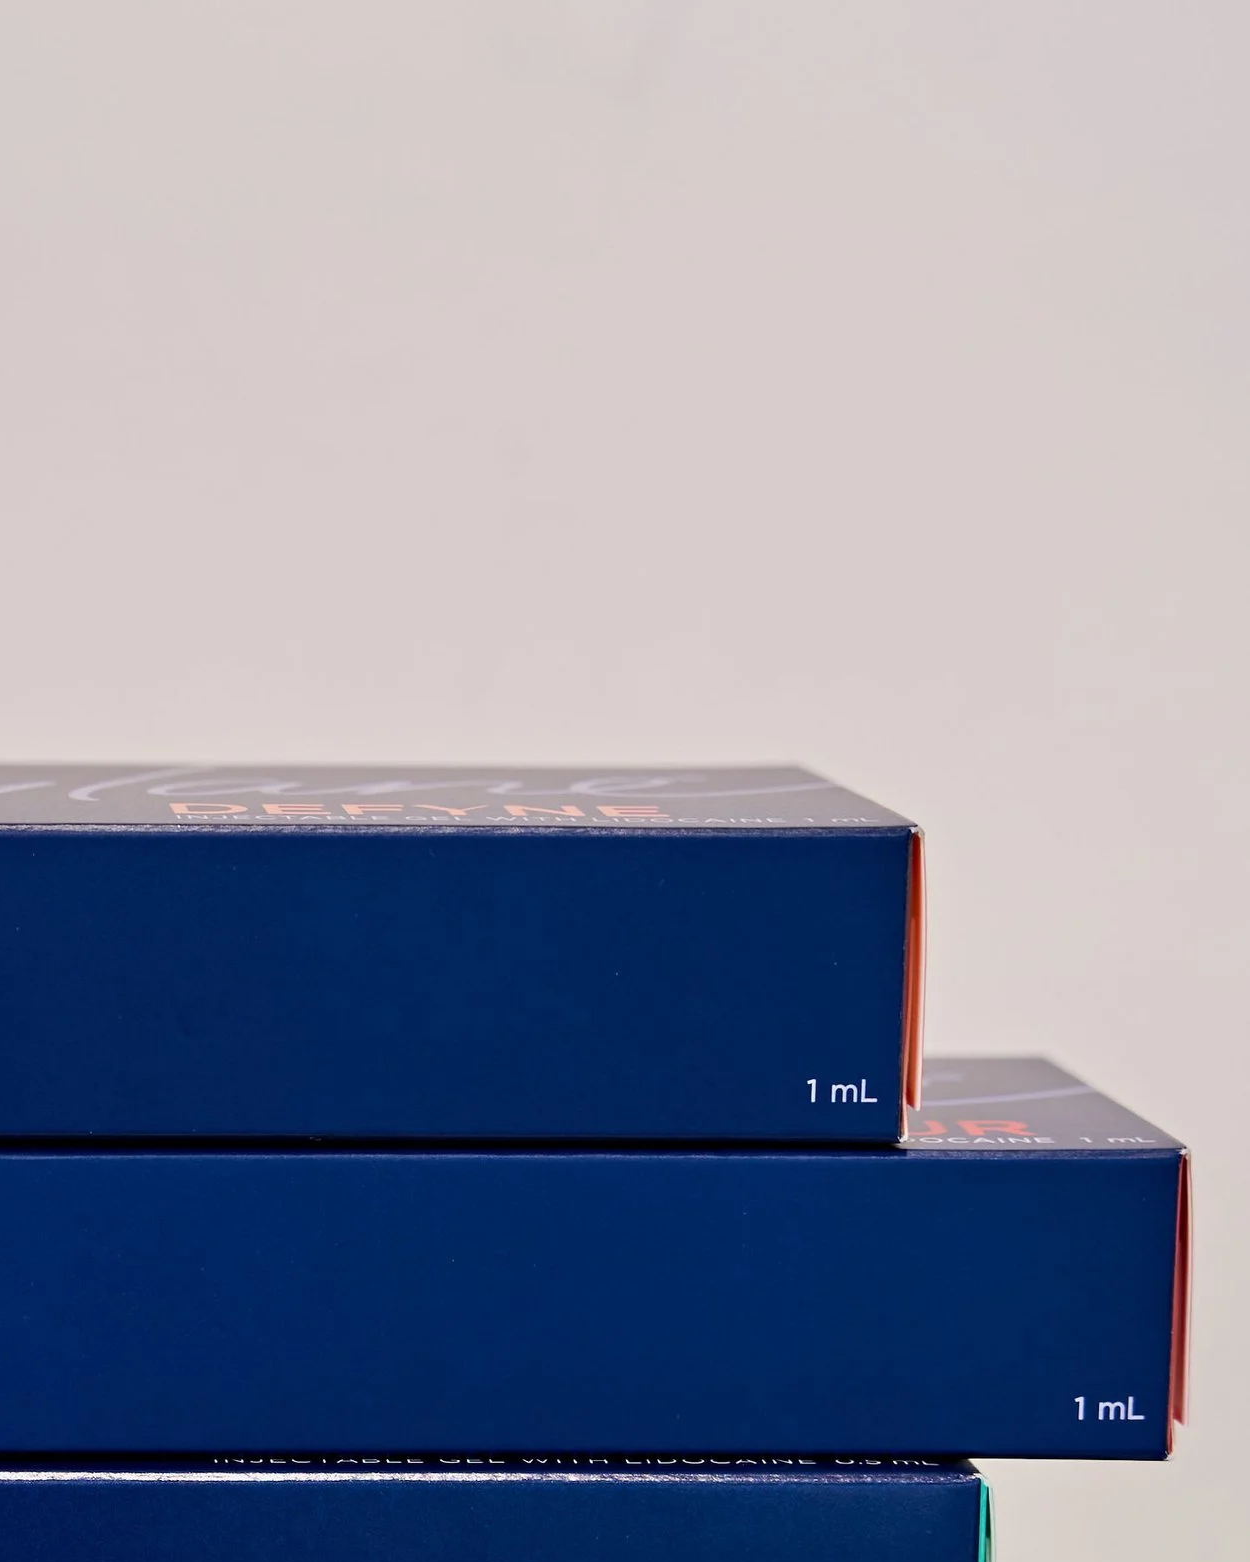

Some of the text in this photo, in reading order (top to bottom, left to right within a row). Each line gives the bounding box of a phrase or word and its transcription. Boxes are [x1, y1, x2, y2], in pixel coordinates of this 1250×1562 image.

[168, 802, 672, 818] DEFYNE
[174, 814, 390, 822] INJECTABLE
[591, 816, 788, 824] LIDOCAINE
[805, 1078, 878, 1103] 1 mL
[909, 1136, 1055, 1145] OCAINE
[1074, 1396, 1145, 1421] 1 mL
